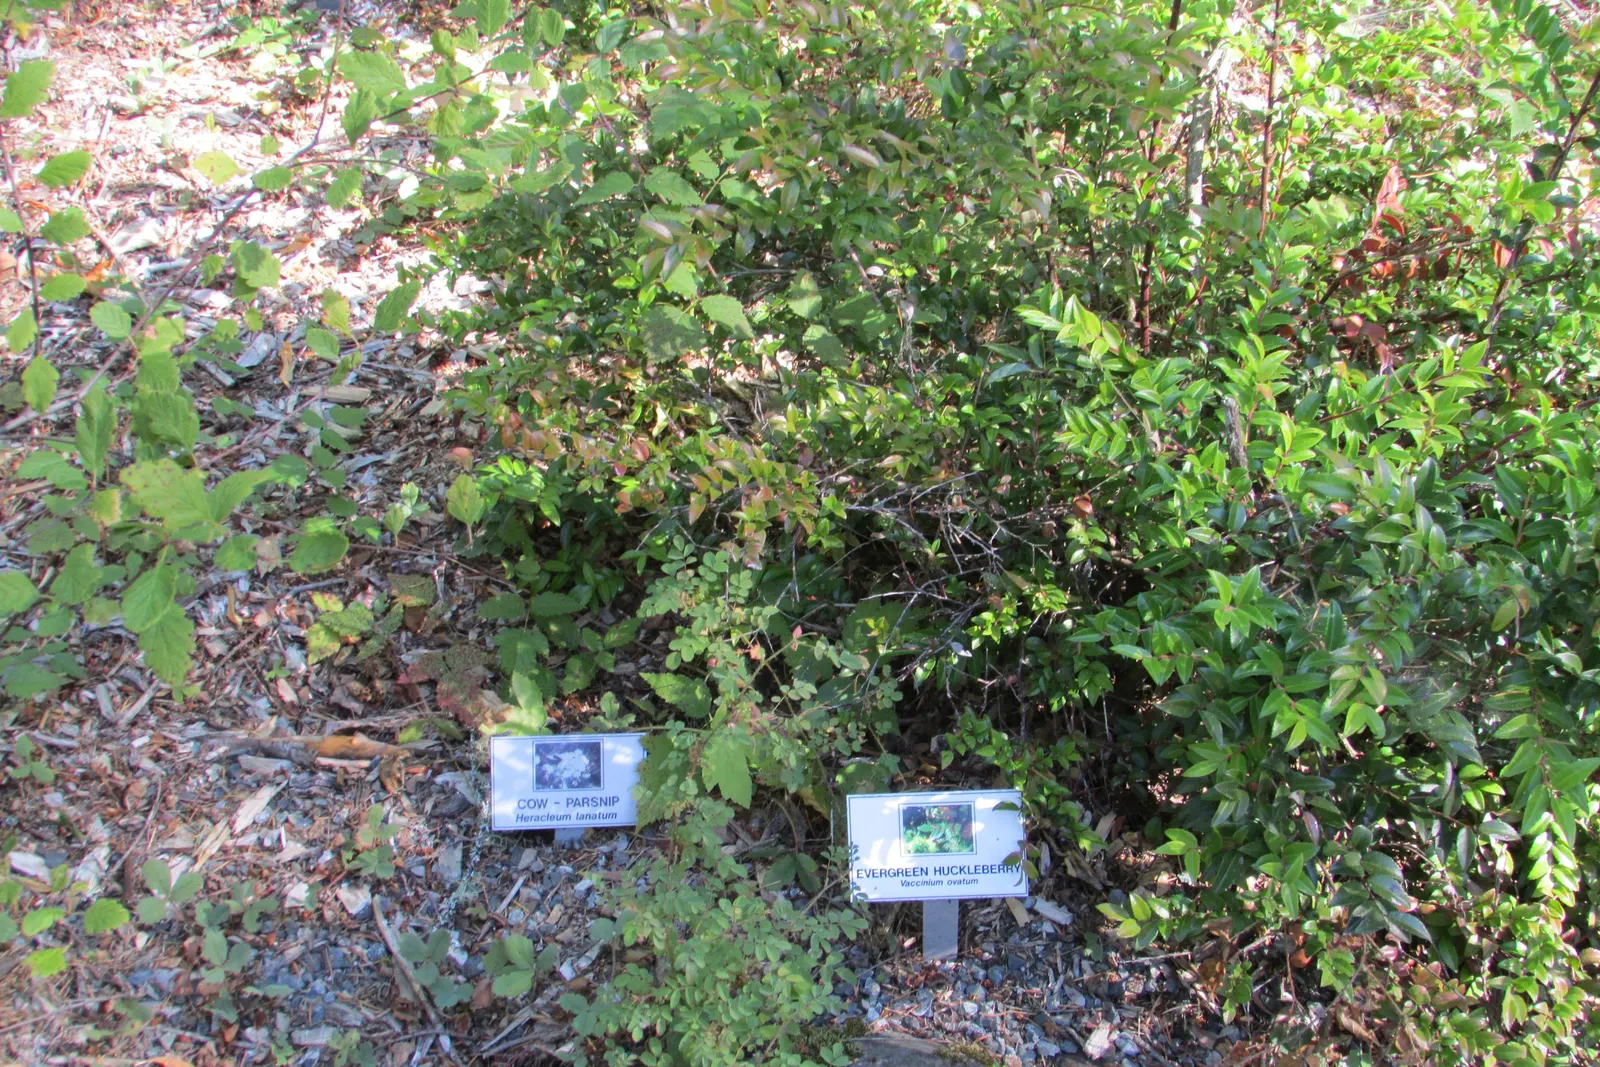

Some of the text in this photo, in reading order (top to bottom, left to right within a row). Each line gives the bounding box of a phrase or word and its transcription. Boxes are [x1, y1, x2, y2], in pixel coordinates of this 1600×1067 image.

[517, 798, 549, 810] COW
[566, 796, 620, 808] PARSNIP
[515, 811, 618, 823] Heracleum lanatum
[856, 864, 1021, 879] EVERGREEN HUCKLEBERRY
[900, 877, 979, 887] Vaccinium ovatum
